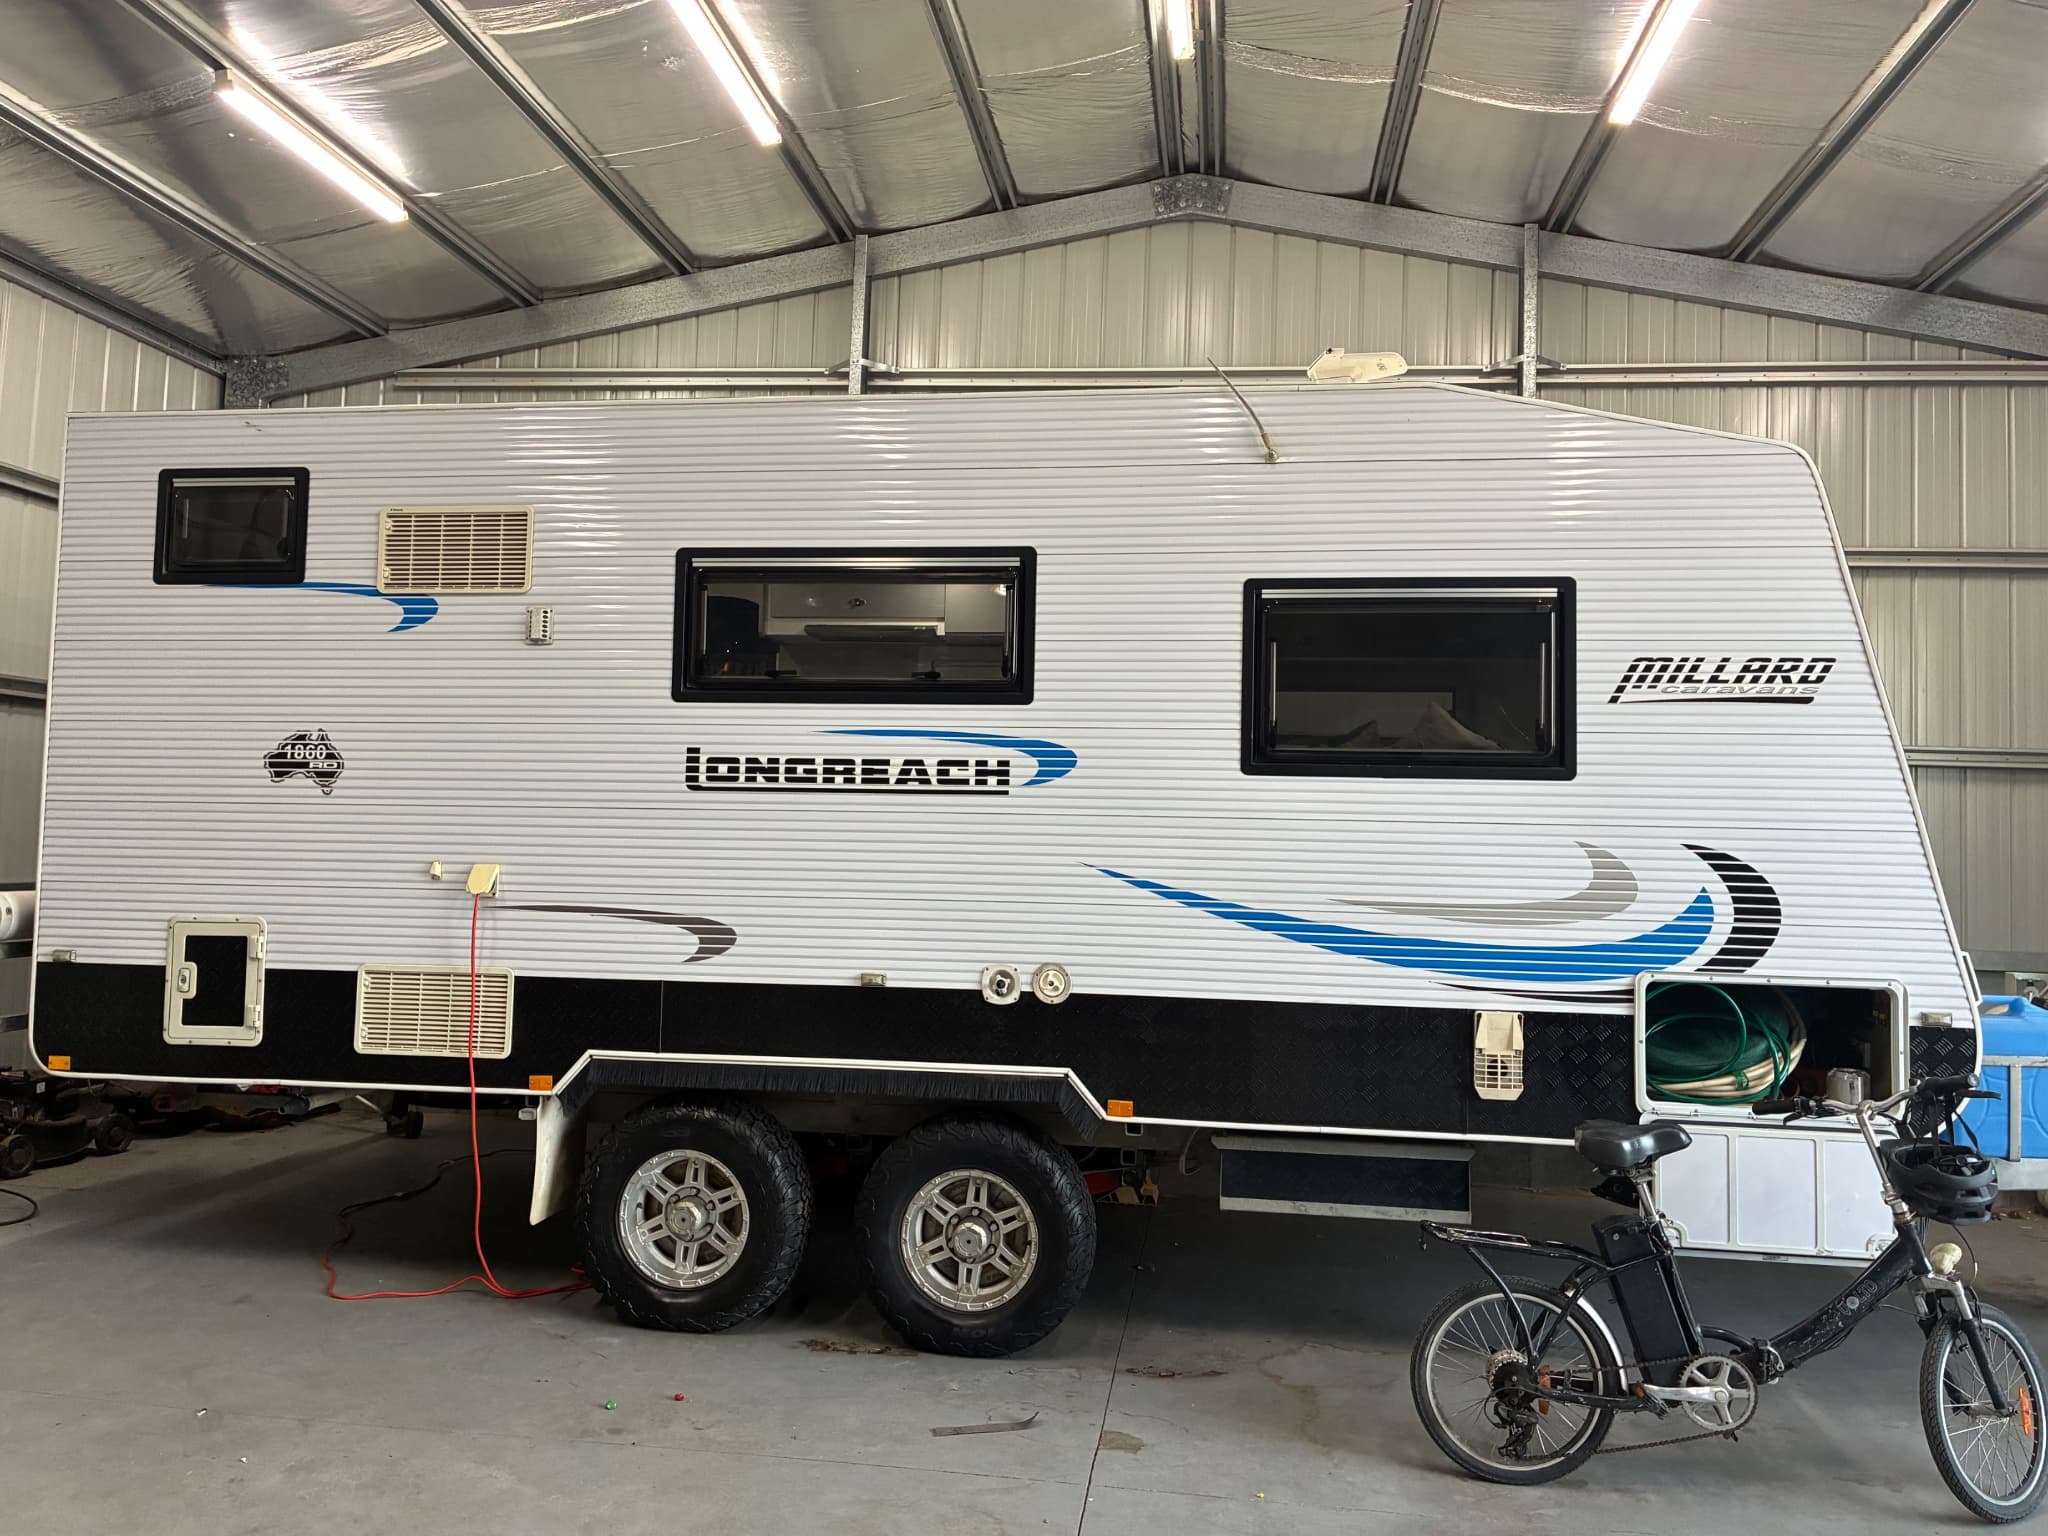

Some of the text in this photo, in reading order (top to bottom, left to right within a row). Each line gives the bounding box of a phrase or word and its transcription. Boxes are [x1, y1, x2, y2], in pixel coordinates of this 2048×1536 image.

[1608, 657, 1837, 703] MILLARD
[1660, 684, 1819, 695] caravans
[285, 744, 326, 759] 1860
[686, 746, 1010, 793] LONGREACH
